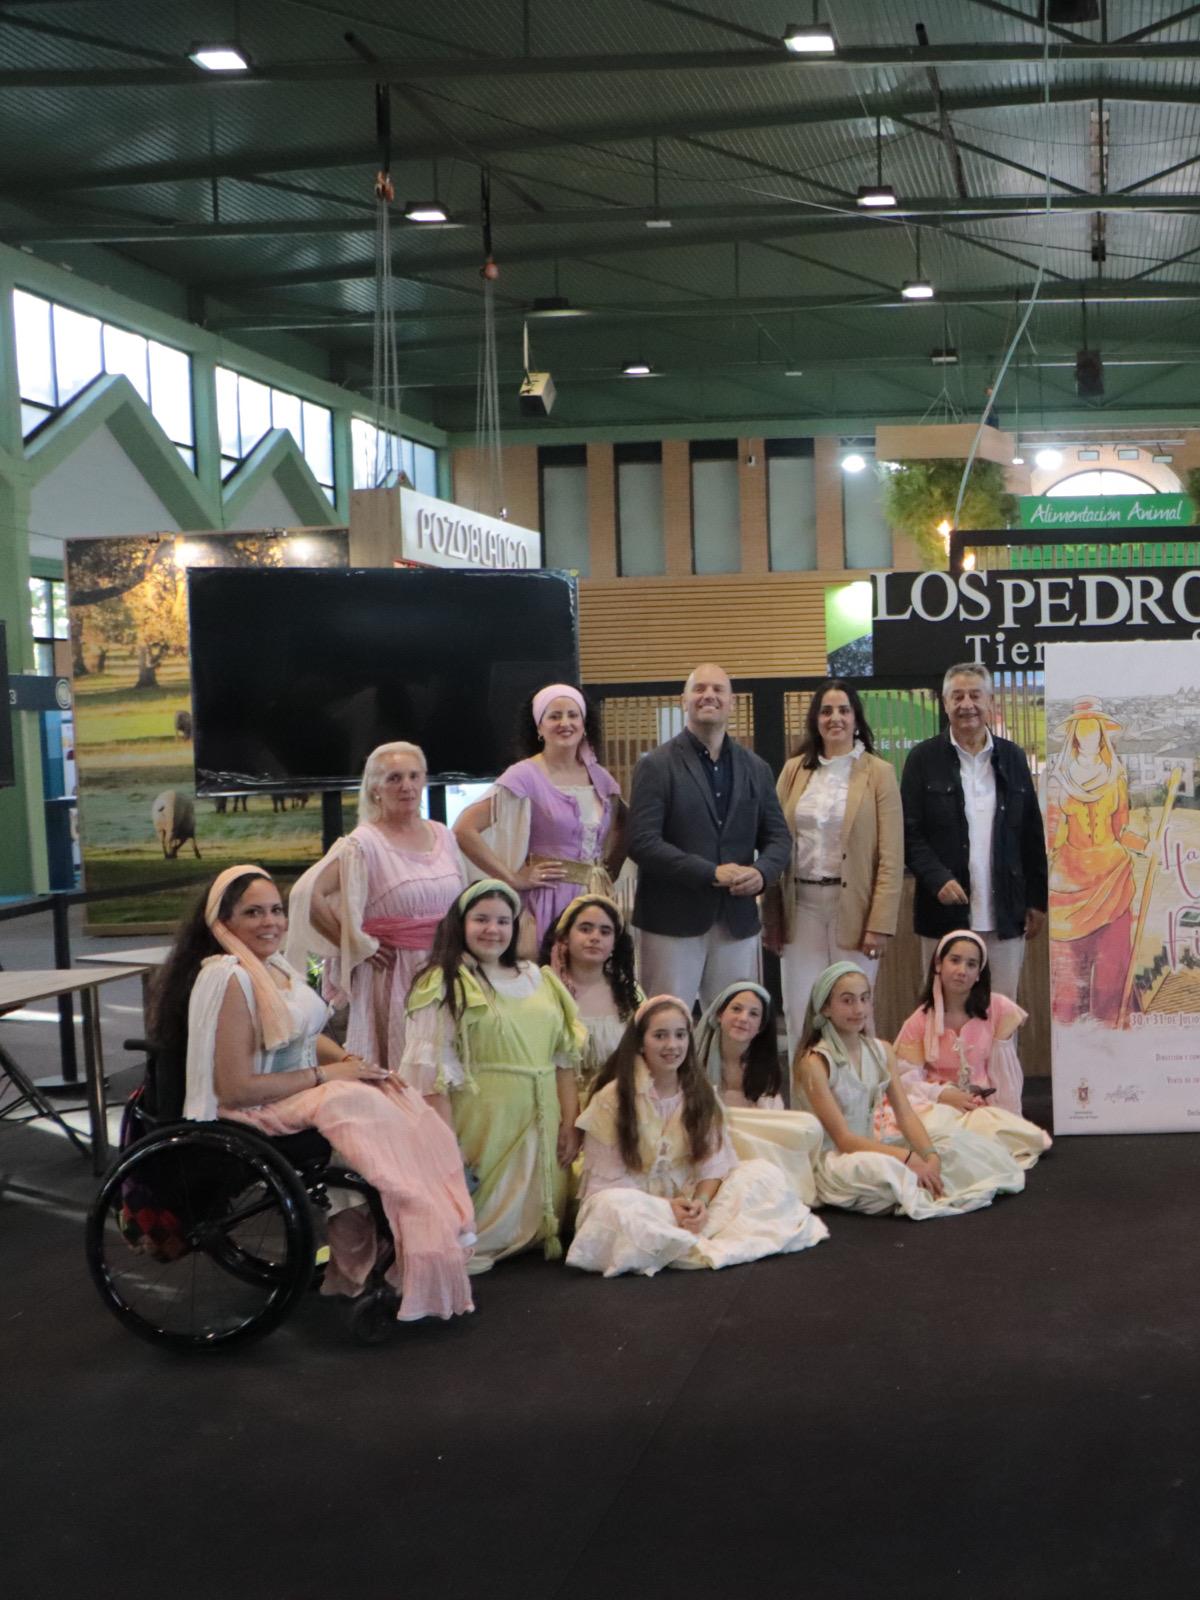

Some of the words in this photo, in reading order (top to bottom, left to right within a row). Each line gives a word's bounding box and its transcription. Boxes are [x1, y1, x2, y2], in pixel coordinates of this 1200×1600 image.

[1030, 503, 1121, 523] Alimentación
[1127, 500, 1183, 520] Animal
[417, 508, 527, 569] POZOBLANCO
[869, 570, 991, 622] LOS
[1131, 1014, 1143, 1026] 30
[1153, 1013, 1164, 1025] 31
